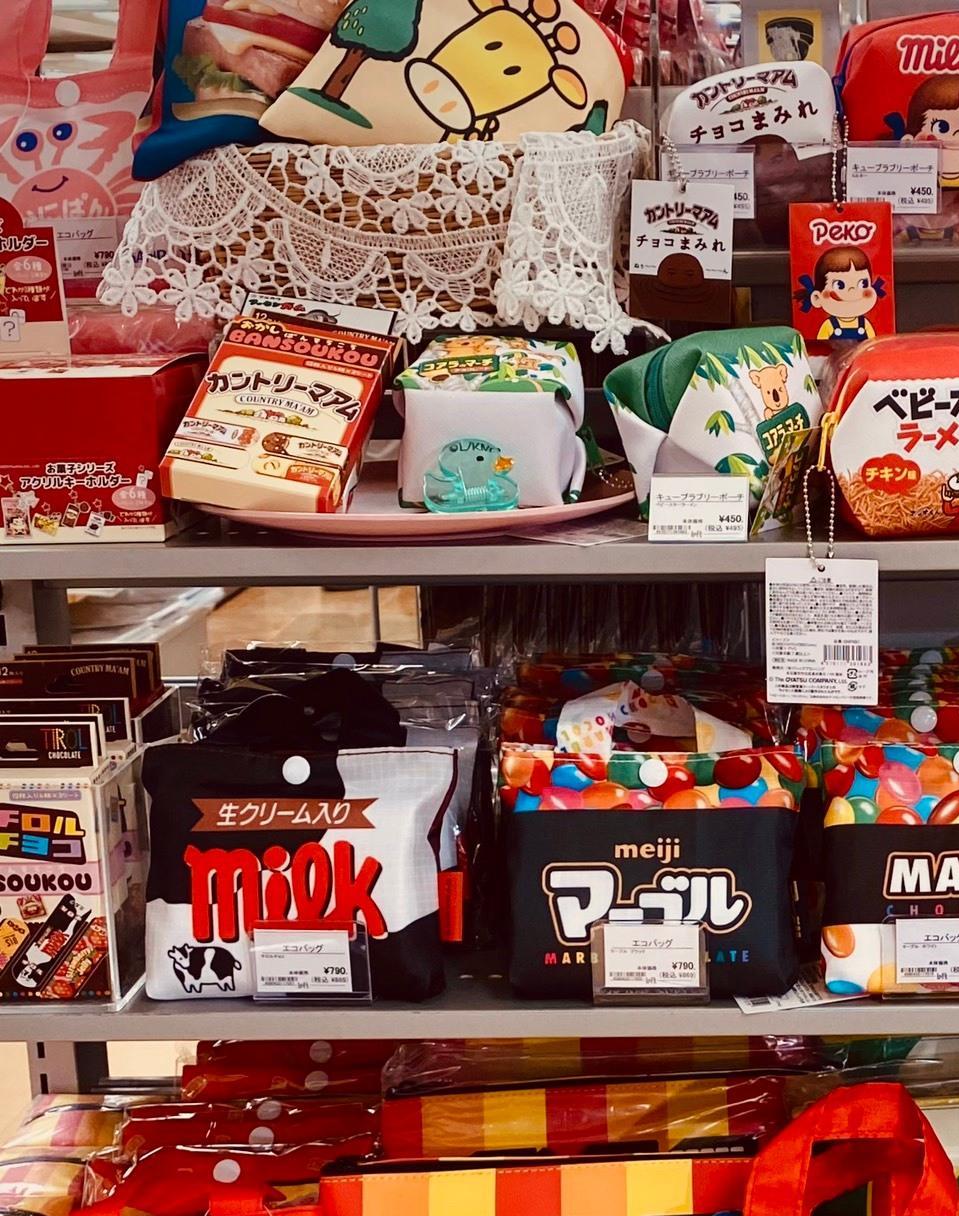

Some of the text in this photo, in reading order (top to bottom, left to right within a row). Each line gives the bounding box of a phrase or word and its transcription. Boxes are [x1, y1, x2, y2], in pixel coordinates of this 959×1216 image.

[691, 69, 799, 109] カントリーマアム
[690, 100, 818, 144] チョコまみれ
[911, 187, 933, 196] ¥450
[644, 202, 719, 230] カントリーマアム
[636, 235, 726, 252] チョコまみれ
[229, 329, 379, 367] BANSOUKOU
[207, 370, 362, 422] カントリーマアム
[240, 396, 315, 417] COUNTRY MA'AM
[46, 462, 116, 475] お菓子シリーズ
[863, 467, 917, 482] チキン味
[21, 476, 132, 489] アクリルキーホルダー
[719, 515, 742, 523] ¥450
[71, 665, 104, 677] COUNTRY
[48, 752, 82, 760] CHOCOLATE
[217, 802, 351, 827] 生クリーム入り
[614, 838, 681, 861] meiji
[184, 841, 389, 943] milk
[549, 868, 746, 939] マーブル
[283, 944, 324, 953] エコバッグ
[632, 939, 673, 948] エコバッグ
[323, 966, 346, 975] ¥790
[672, 962, 694, 970] ¥790
